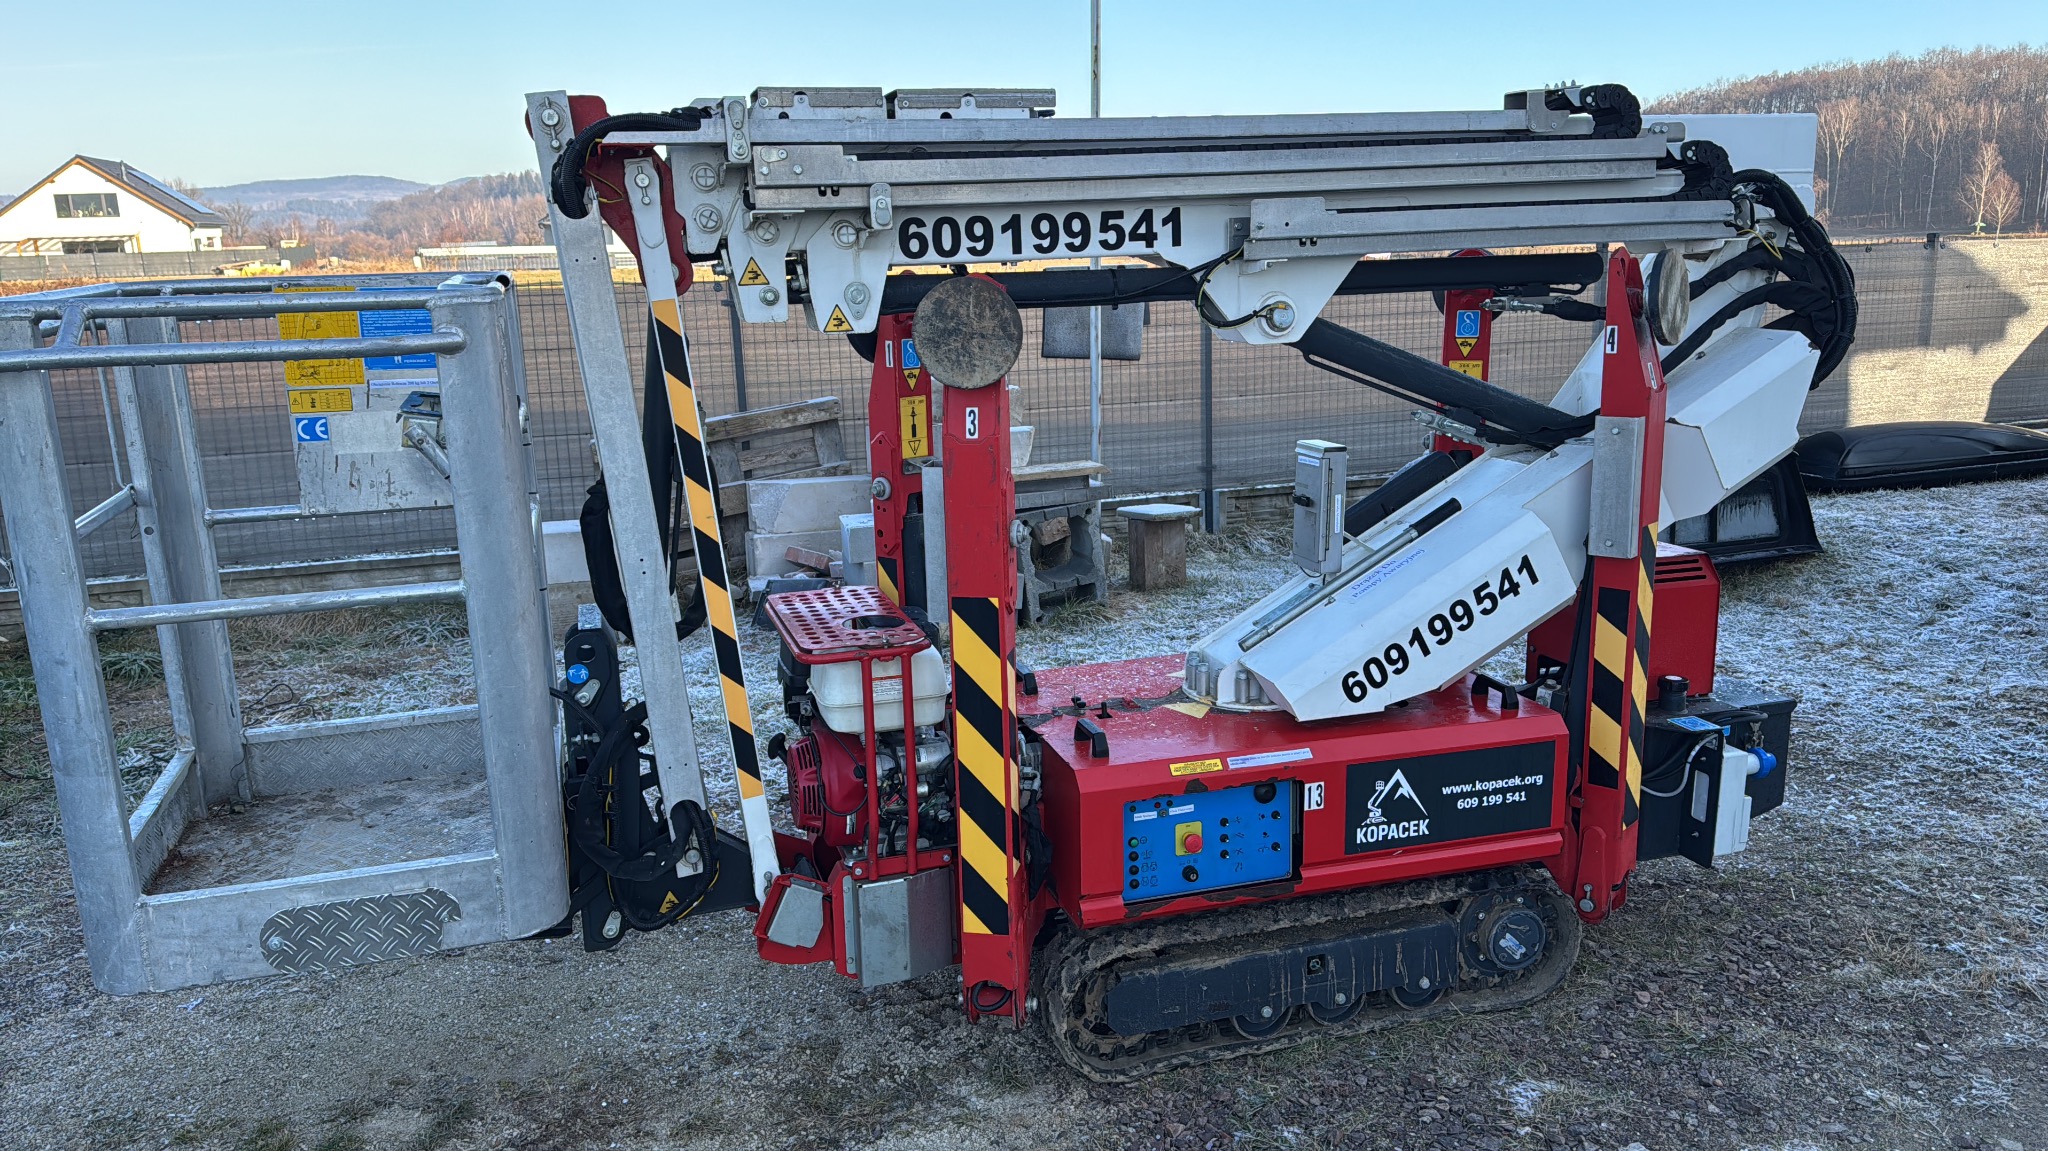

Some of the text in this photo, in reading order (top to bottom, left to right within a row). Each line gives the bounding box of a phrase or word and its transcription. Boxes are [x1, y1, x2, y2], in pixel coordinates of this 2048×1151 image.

[899, 207, 1182, 259] 609199541
[1607, 327, 1616, 352] 4
[297, 418, 329, 440] CE
[968, 409, 977, 437] 3
[1351, 548, 1426, 598] Pompy Awaryjnej
[1382, 560, 1397, 570] Do
[1341, 554, 1539, 704] 609199541
[1307, 784, 1323, 809] 13
[1442, 774, 1543, 796] www.kopacek.org
[1457, 791, 1526, 809] 609 199 541
[1356, 818, 1430, 844] KOPACEK
